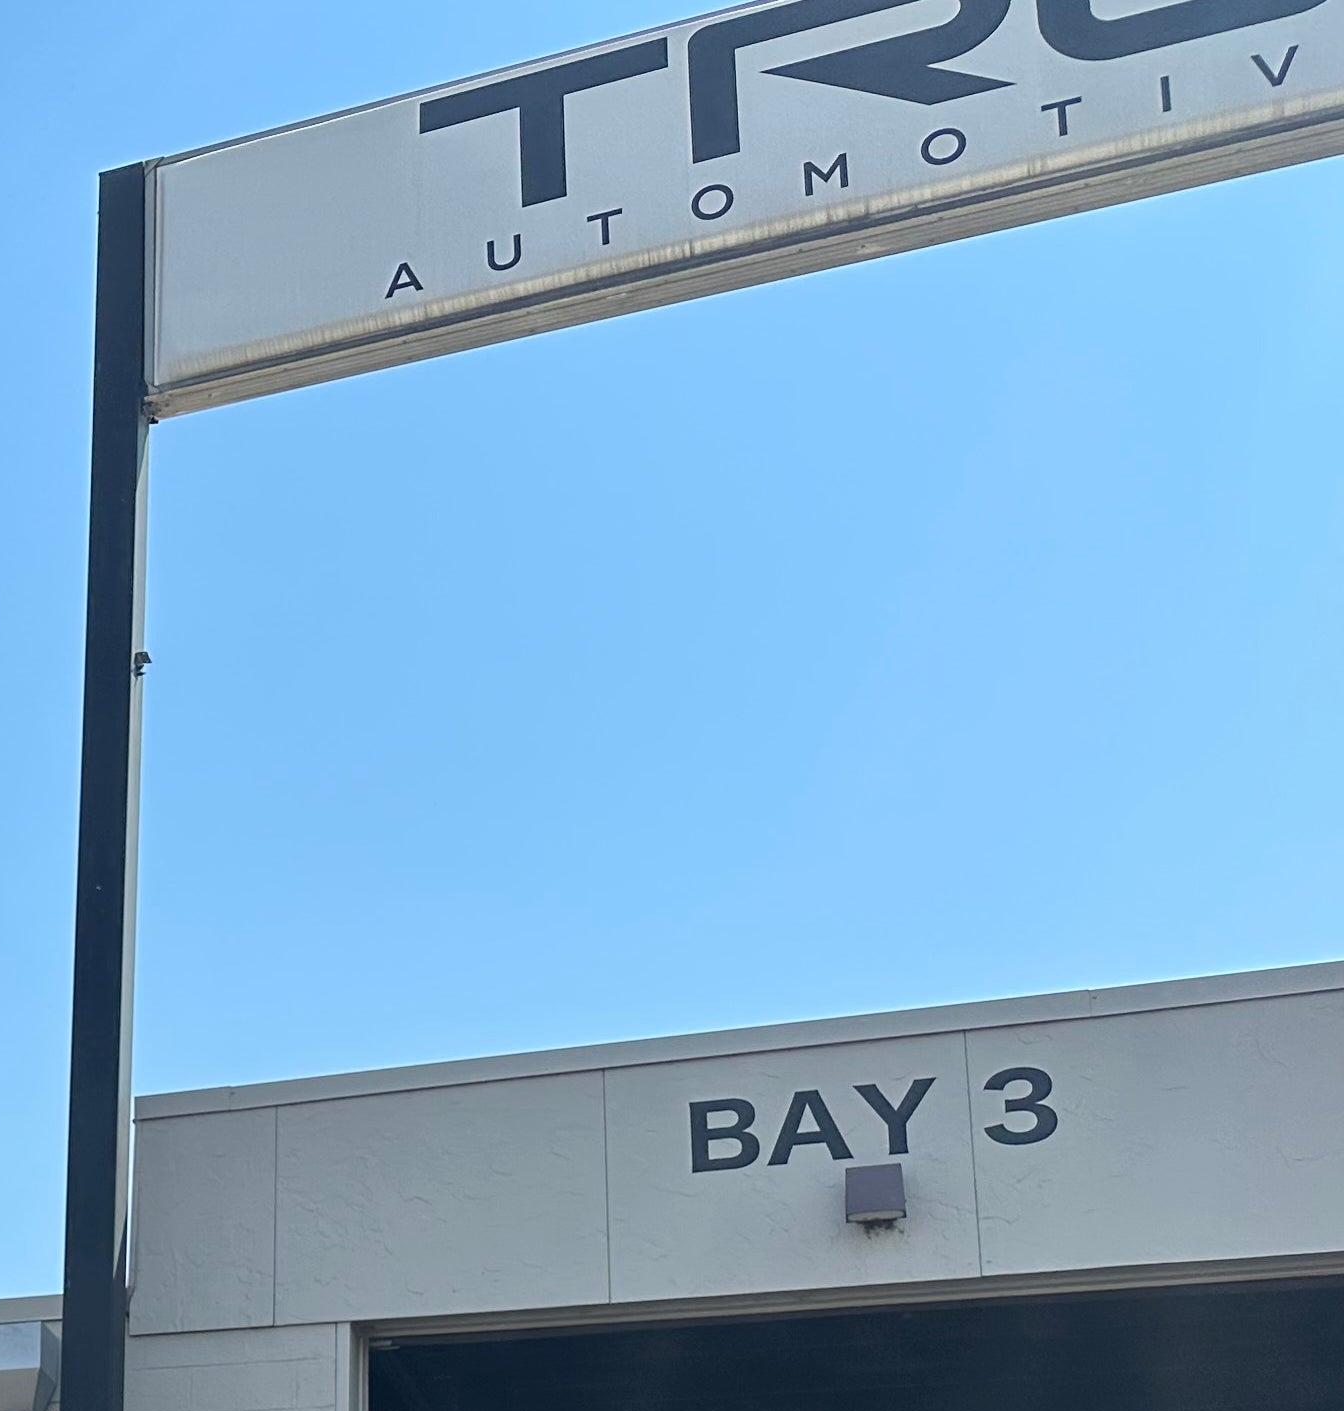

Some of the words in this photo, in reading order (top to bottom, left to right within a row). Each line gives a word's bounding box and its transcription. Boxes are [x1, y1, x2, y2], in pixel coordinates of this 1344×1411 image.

[385, 44, 1300, 299] AUTOMOTIV
[689, 1077, 937, 1173] BAY
[983, 1067, 1058, 1146] 3
